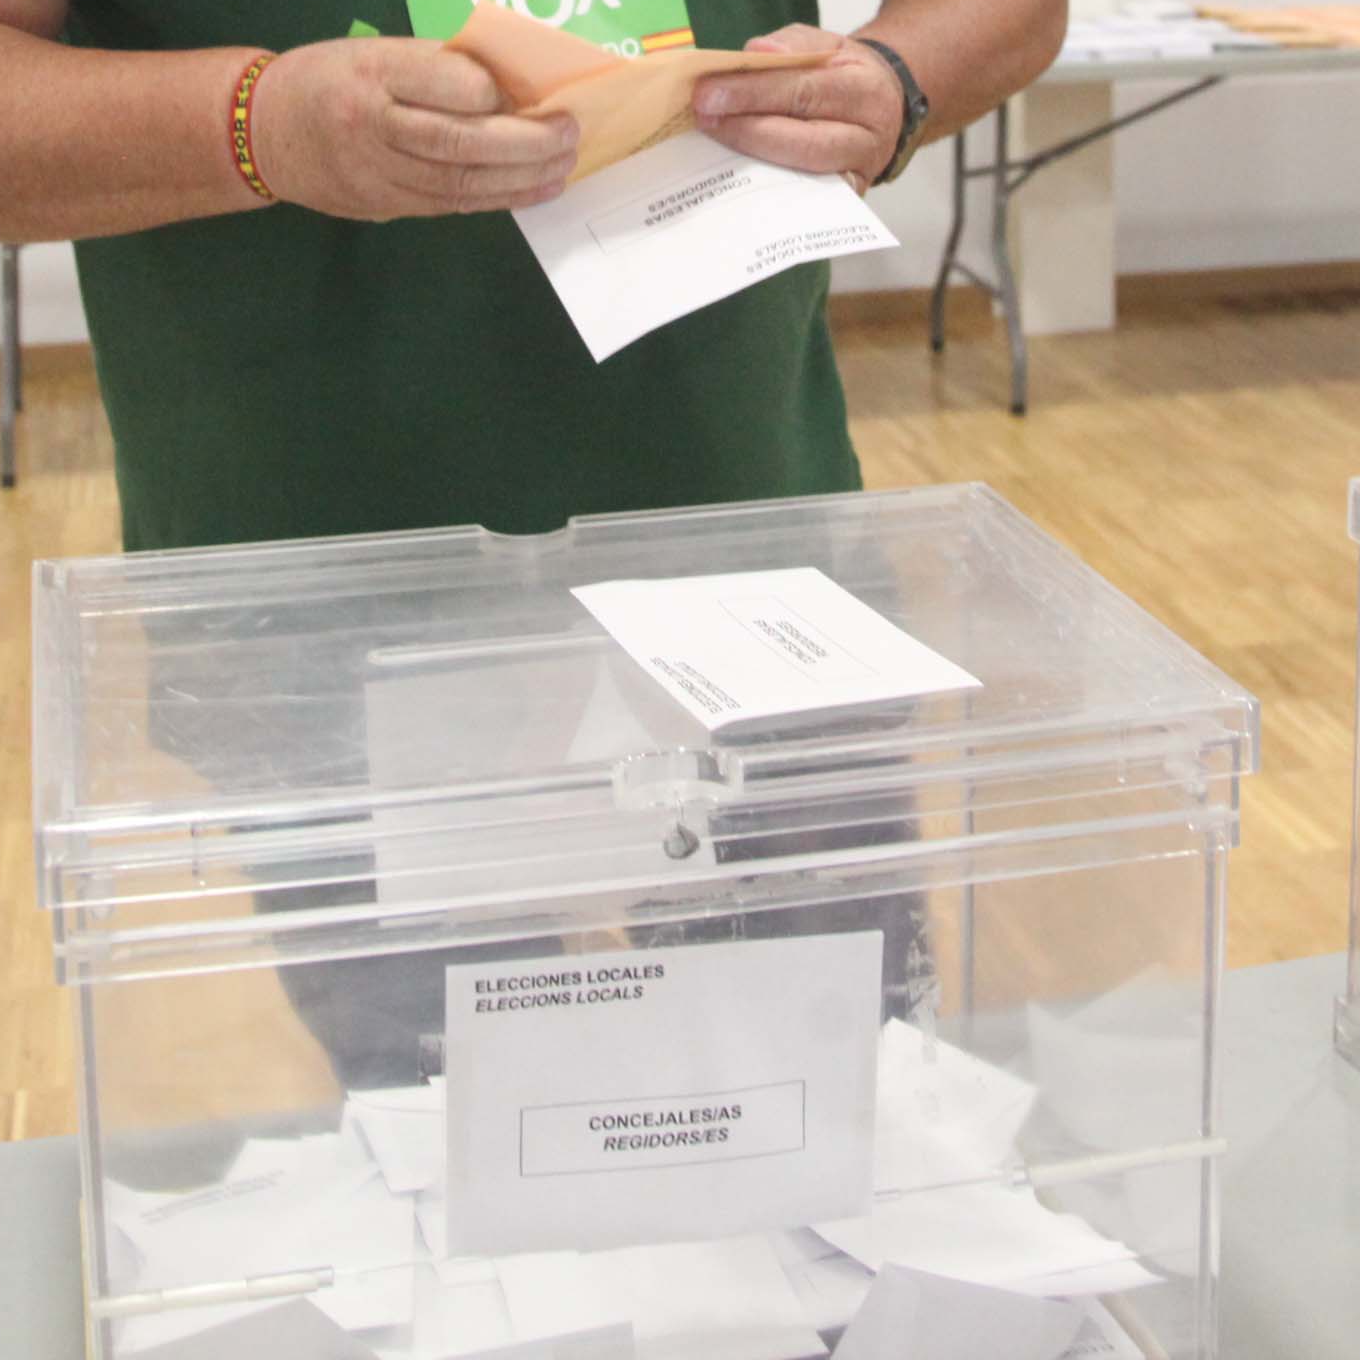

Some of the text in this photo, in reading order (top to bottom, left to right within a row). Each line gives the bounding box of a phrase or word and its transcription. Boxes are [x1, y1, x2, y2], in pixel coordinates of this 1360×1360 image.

[475, 964, 665, 994] ELECCIONES LOCALES
[475, 986, 644, 1013] ELECCIONS LOCALS
[589, 1104, 743, 1131] CONCEJALES/AS
[603, 1127, 730, 1151] REGIDORS/ES
